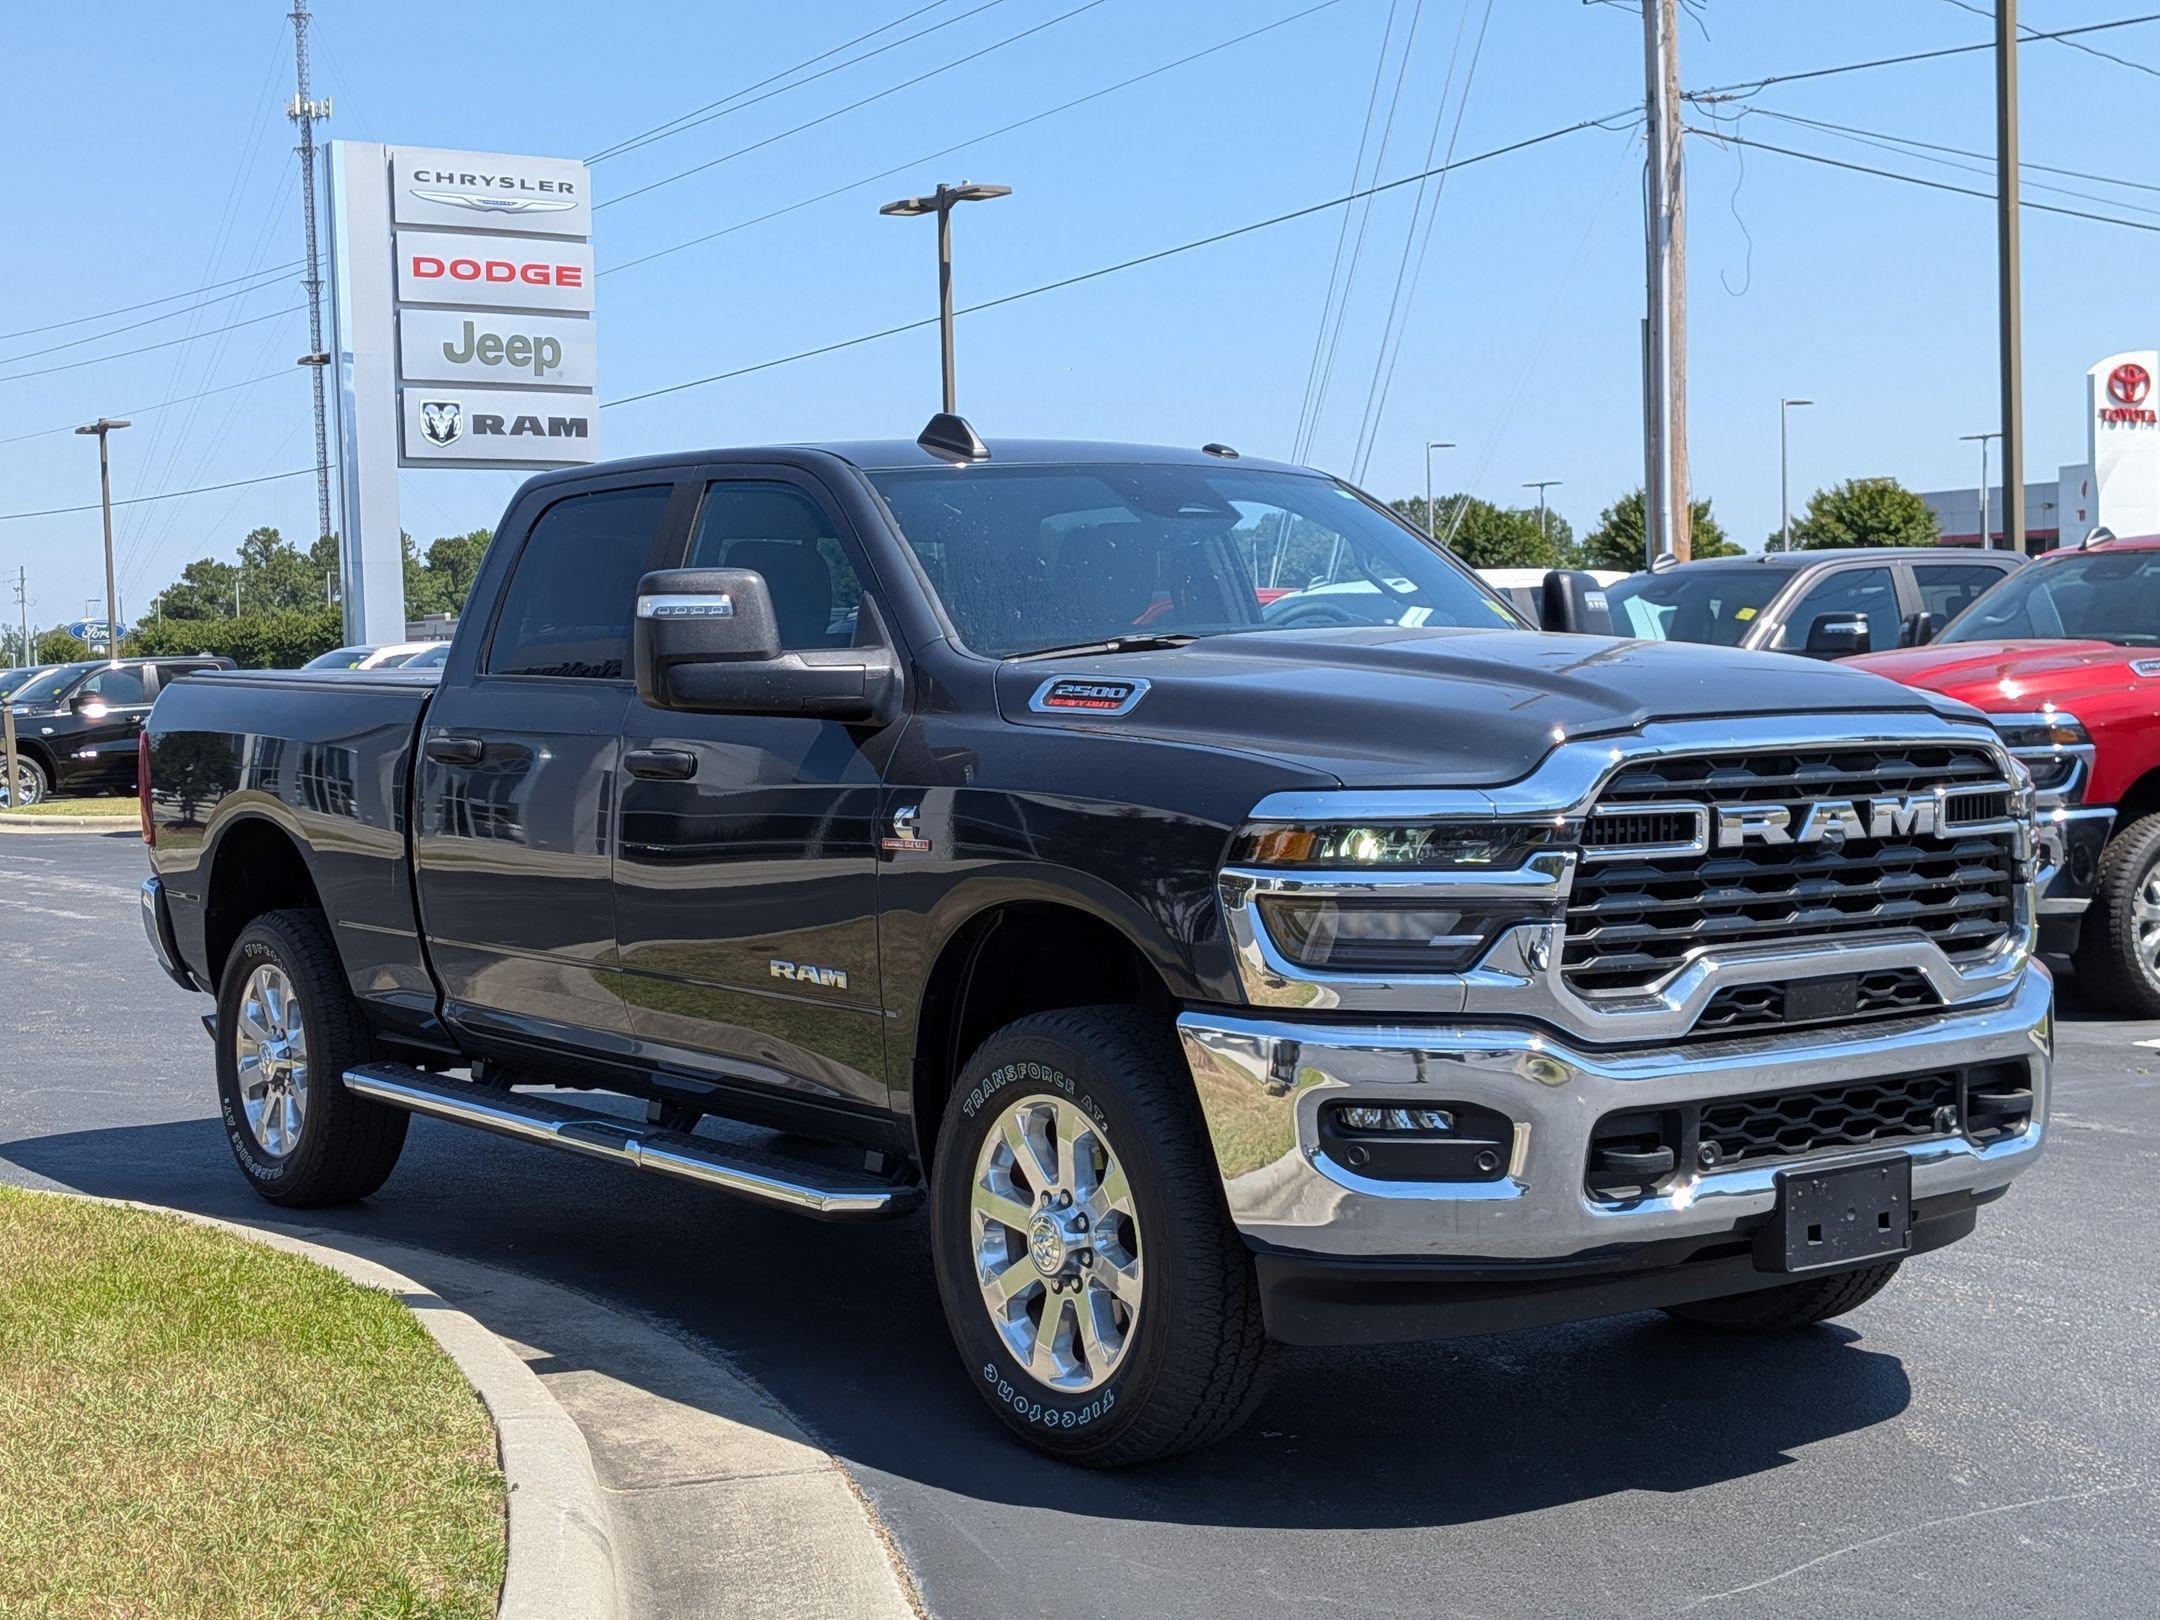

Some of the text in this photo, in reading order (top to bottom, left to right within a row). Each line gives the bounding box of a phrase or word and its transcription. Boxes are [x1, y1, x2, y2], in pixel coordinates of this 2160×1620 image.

[413, 170, 575, 194] CHRYSLER
[412, 256, 583, 288] DODGE
[442, 320, 562, 377] Jeep
[472, 414, 588, 438] RAM
[2097, 408, 2157, 423] TOYOTA
[1054, 684, 1128, 699] 2500
[1717, 795, 1936, 848] RAM
[770, 959, 848, 990] RAM
[963, 1062, 1076, 1118] TRANSFORCE
